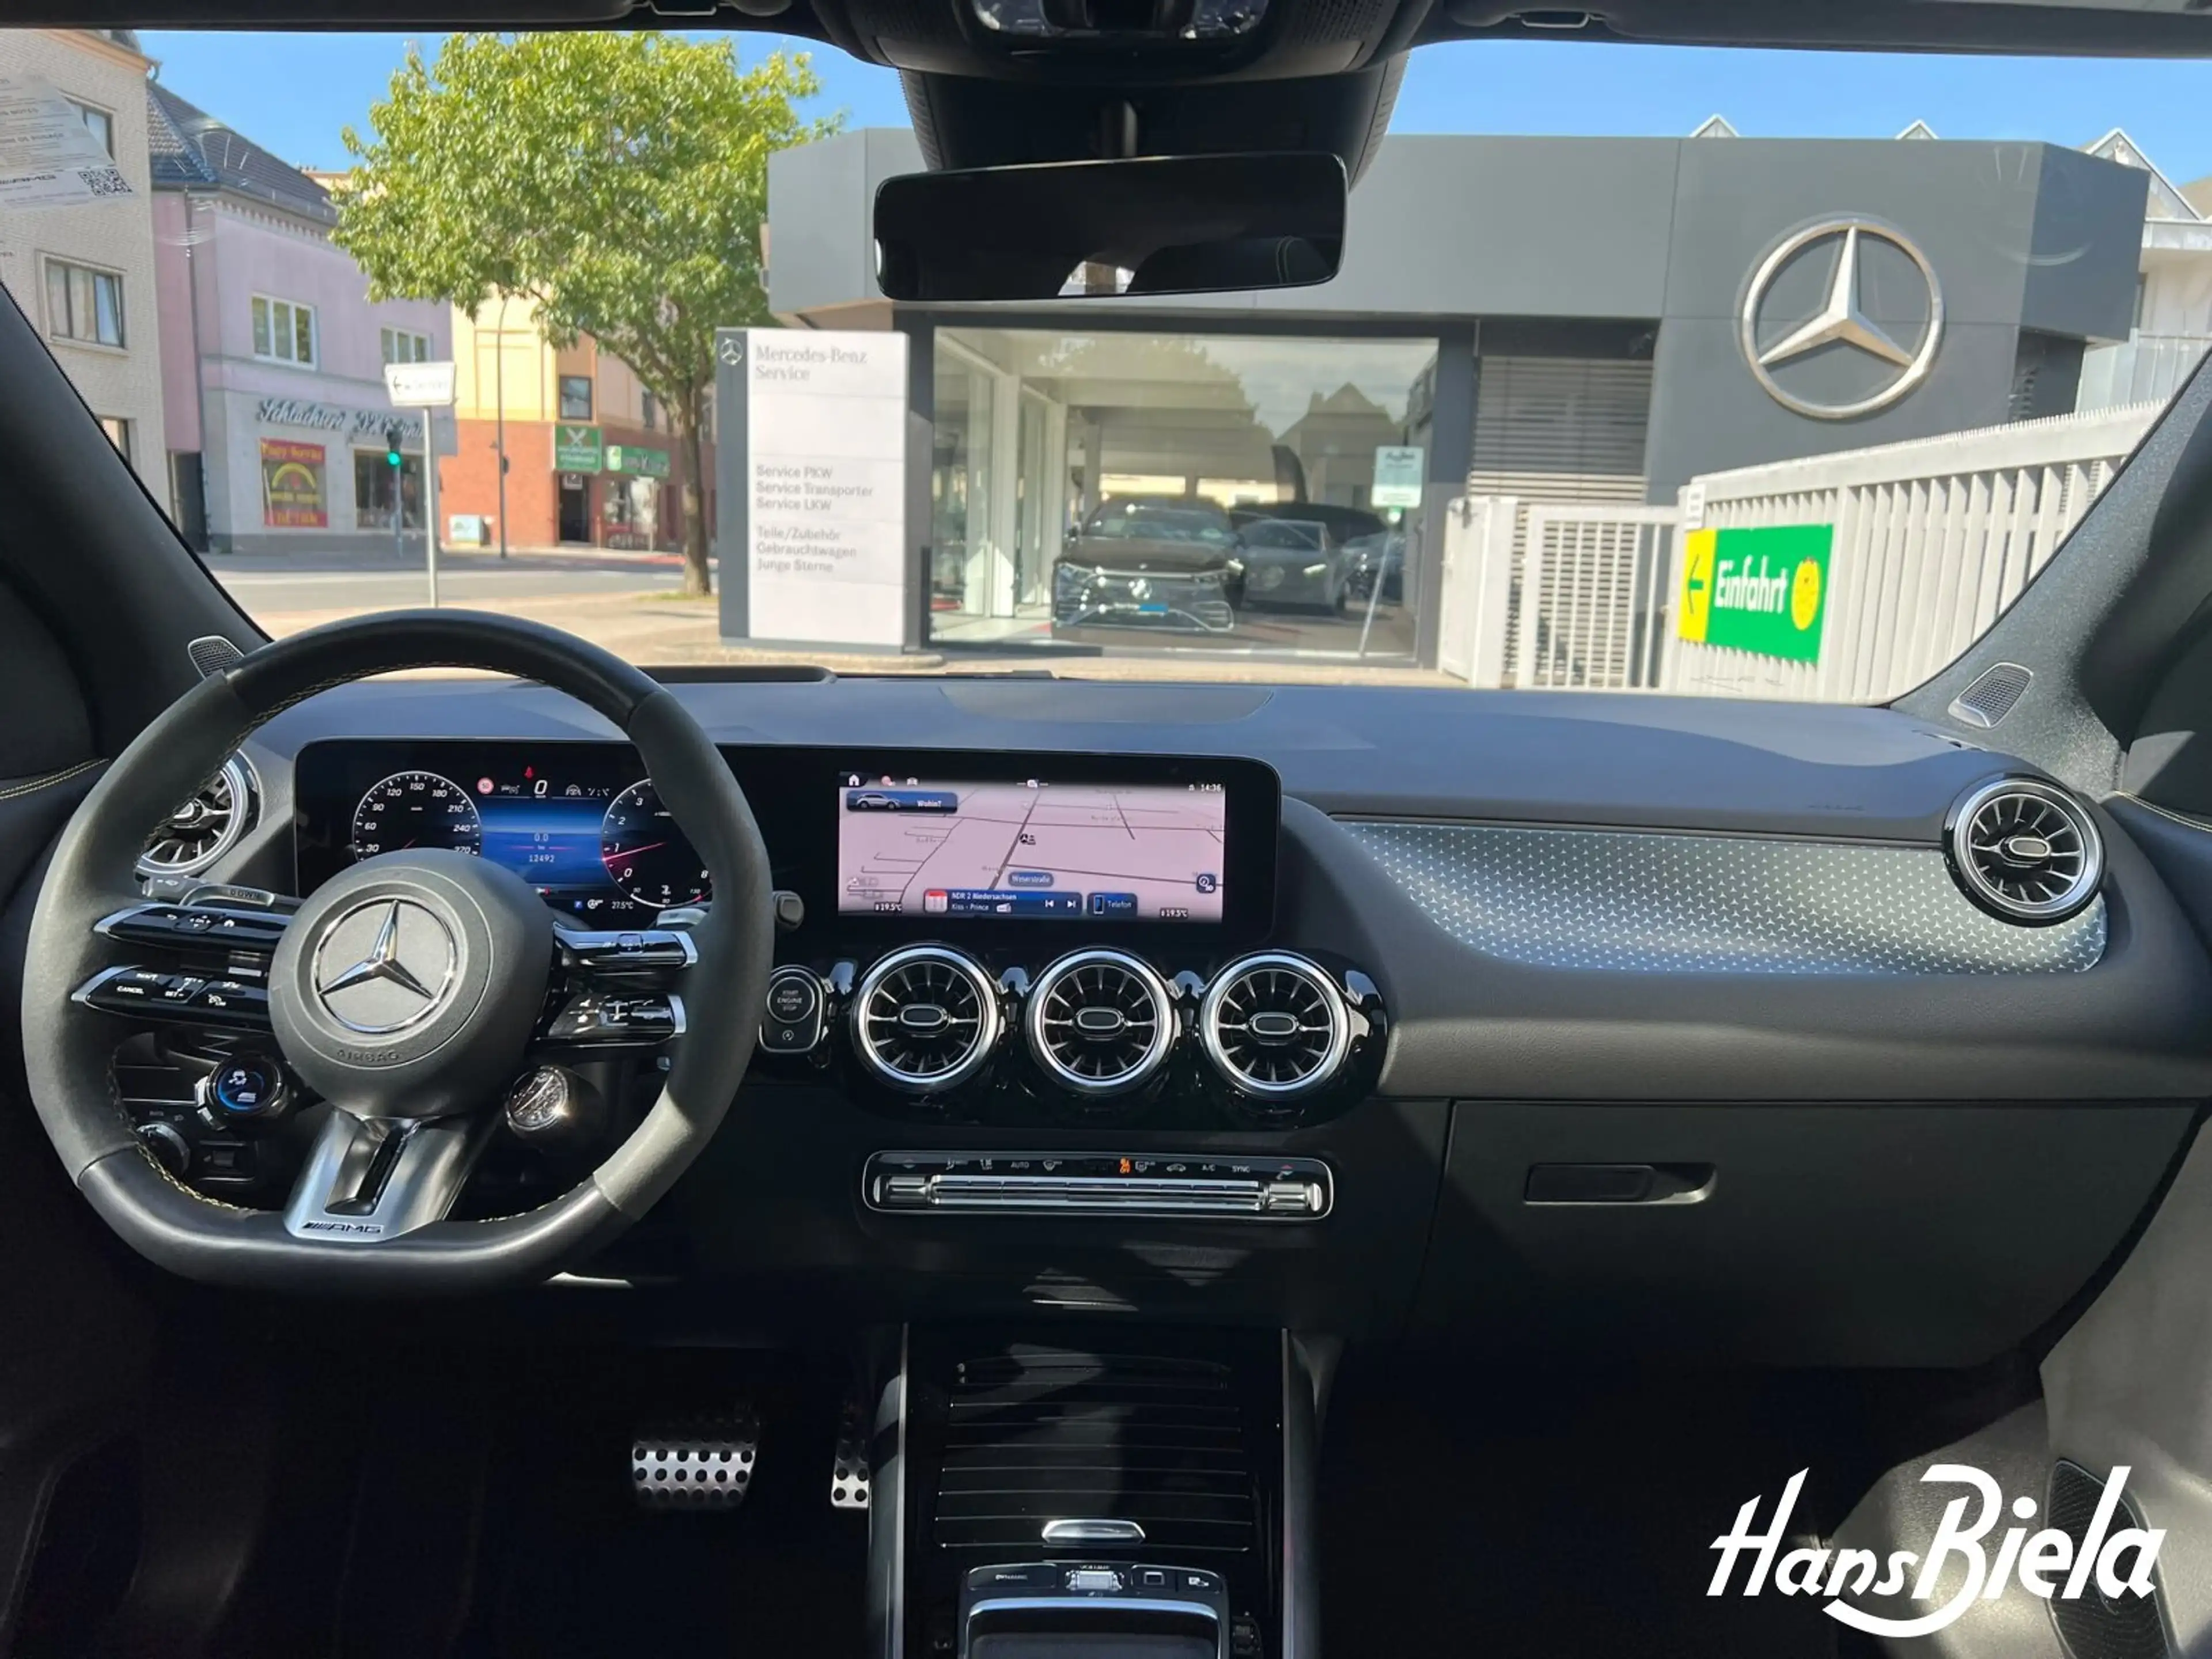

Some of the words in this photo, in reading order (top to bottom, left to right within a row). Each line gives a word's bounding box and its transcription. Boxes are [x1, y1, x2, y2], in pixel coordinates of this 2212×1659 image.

[756, 343, 868, 364] Mercedes-Benz
[755, 366, 810, 381] Service
[757, 464, 801, 479] Service
[757, 480, 801, 495] Service
[804, 483, 873, 498] Transporter
[756, 497, 801, 511] Service
[757, 541, 857, 559] Gebrauchtwagen
[1714, 554, 1789, 613] Einfahrt
[387, 787, 402, 796] 120
[410, 782, 425, 791] 150
[432, 789, 448, 797] 180
[635, 797, 644, 806] 3
[372, 803, 385, 812] 90
[618, 816, 626, 825] 2
[364, 822, 377, 831] 60
[453, 824, 471, 832] 240
[366, 844, 380, 853] 30
[614, 843, 620, 853] 1
[623, 868, 633, 878] 0
[1107, 900, 1132, 910] Telefon
[337, 1048, 400, 1063] AIRBAG
[327, 1223, 381, 1234] AMG
